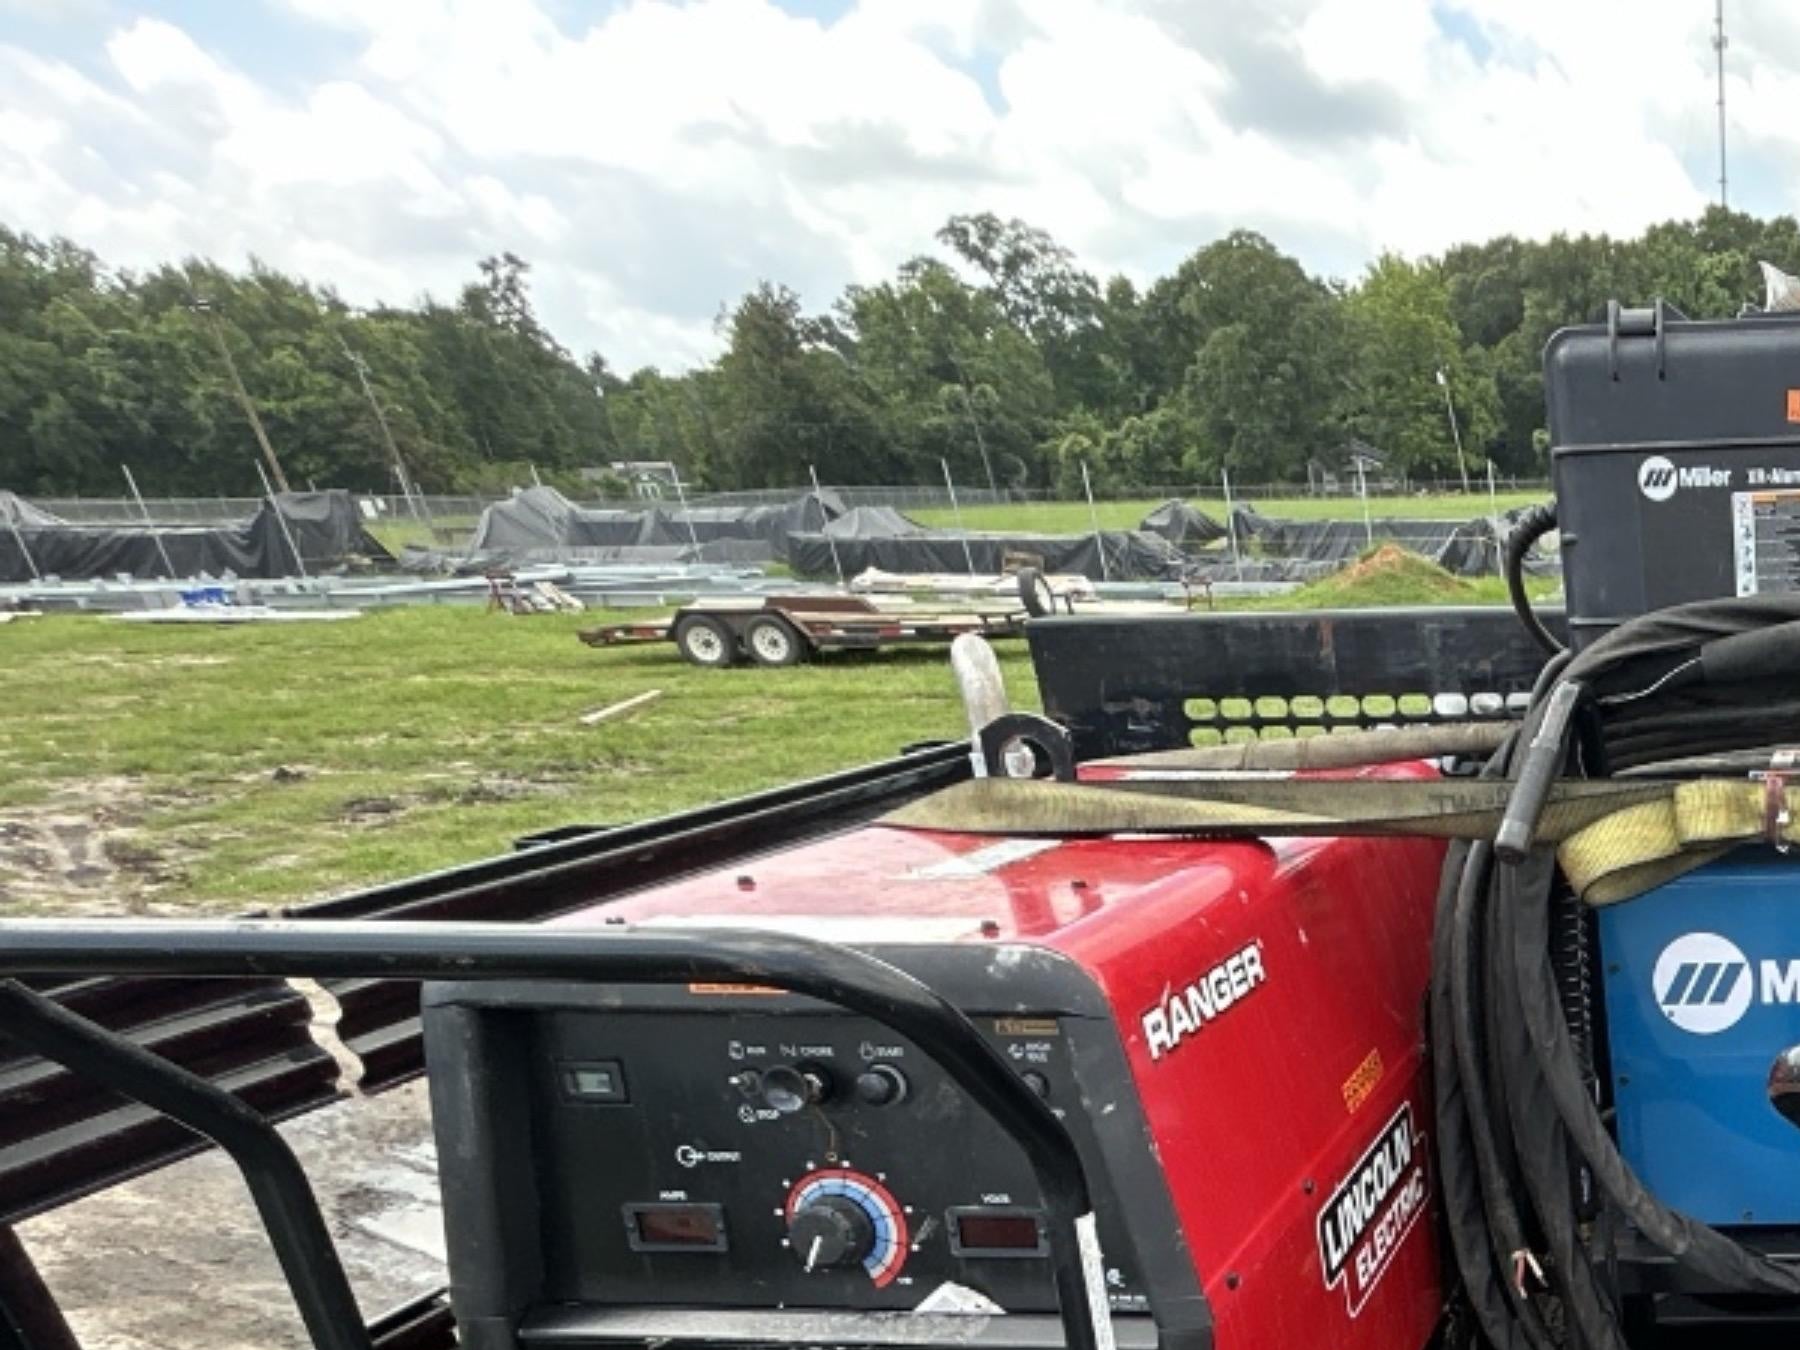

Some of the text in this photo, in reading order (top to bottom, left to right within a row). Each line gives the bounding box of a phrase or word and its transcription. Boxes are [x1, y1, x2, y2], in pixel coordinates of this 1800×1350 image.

[1679, 465, 1732, 487] Miller
[1141, 943, 1266, 1058] RANGER
[1323, 1117, 1412, 1271] LINCOLN
[1356, 1167, 1424, 1290] ELECTRIC
